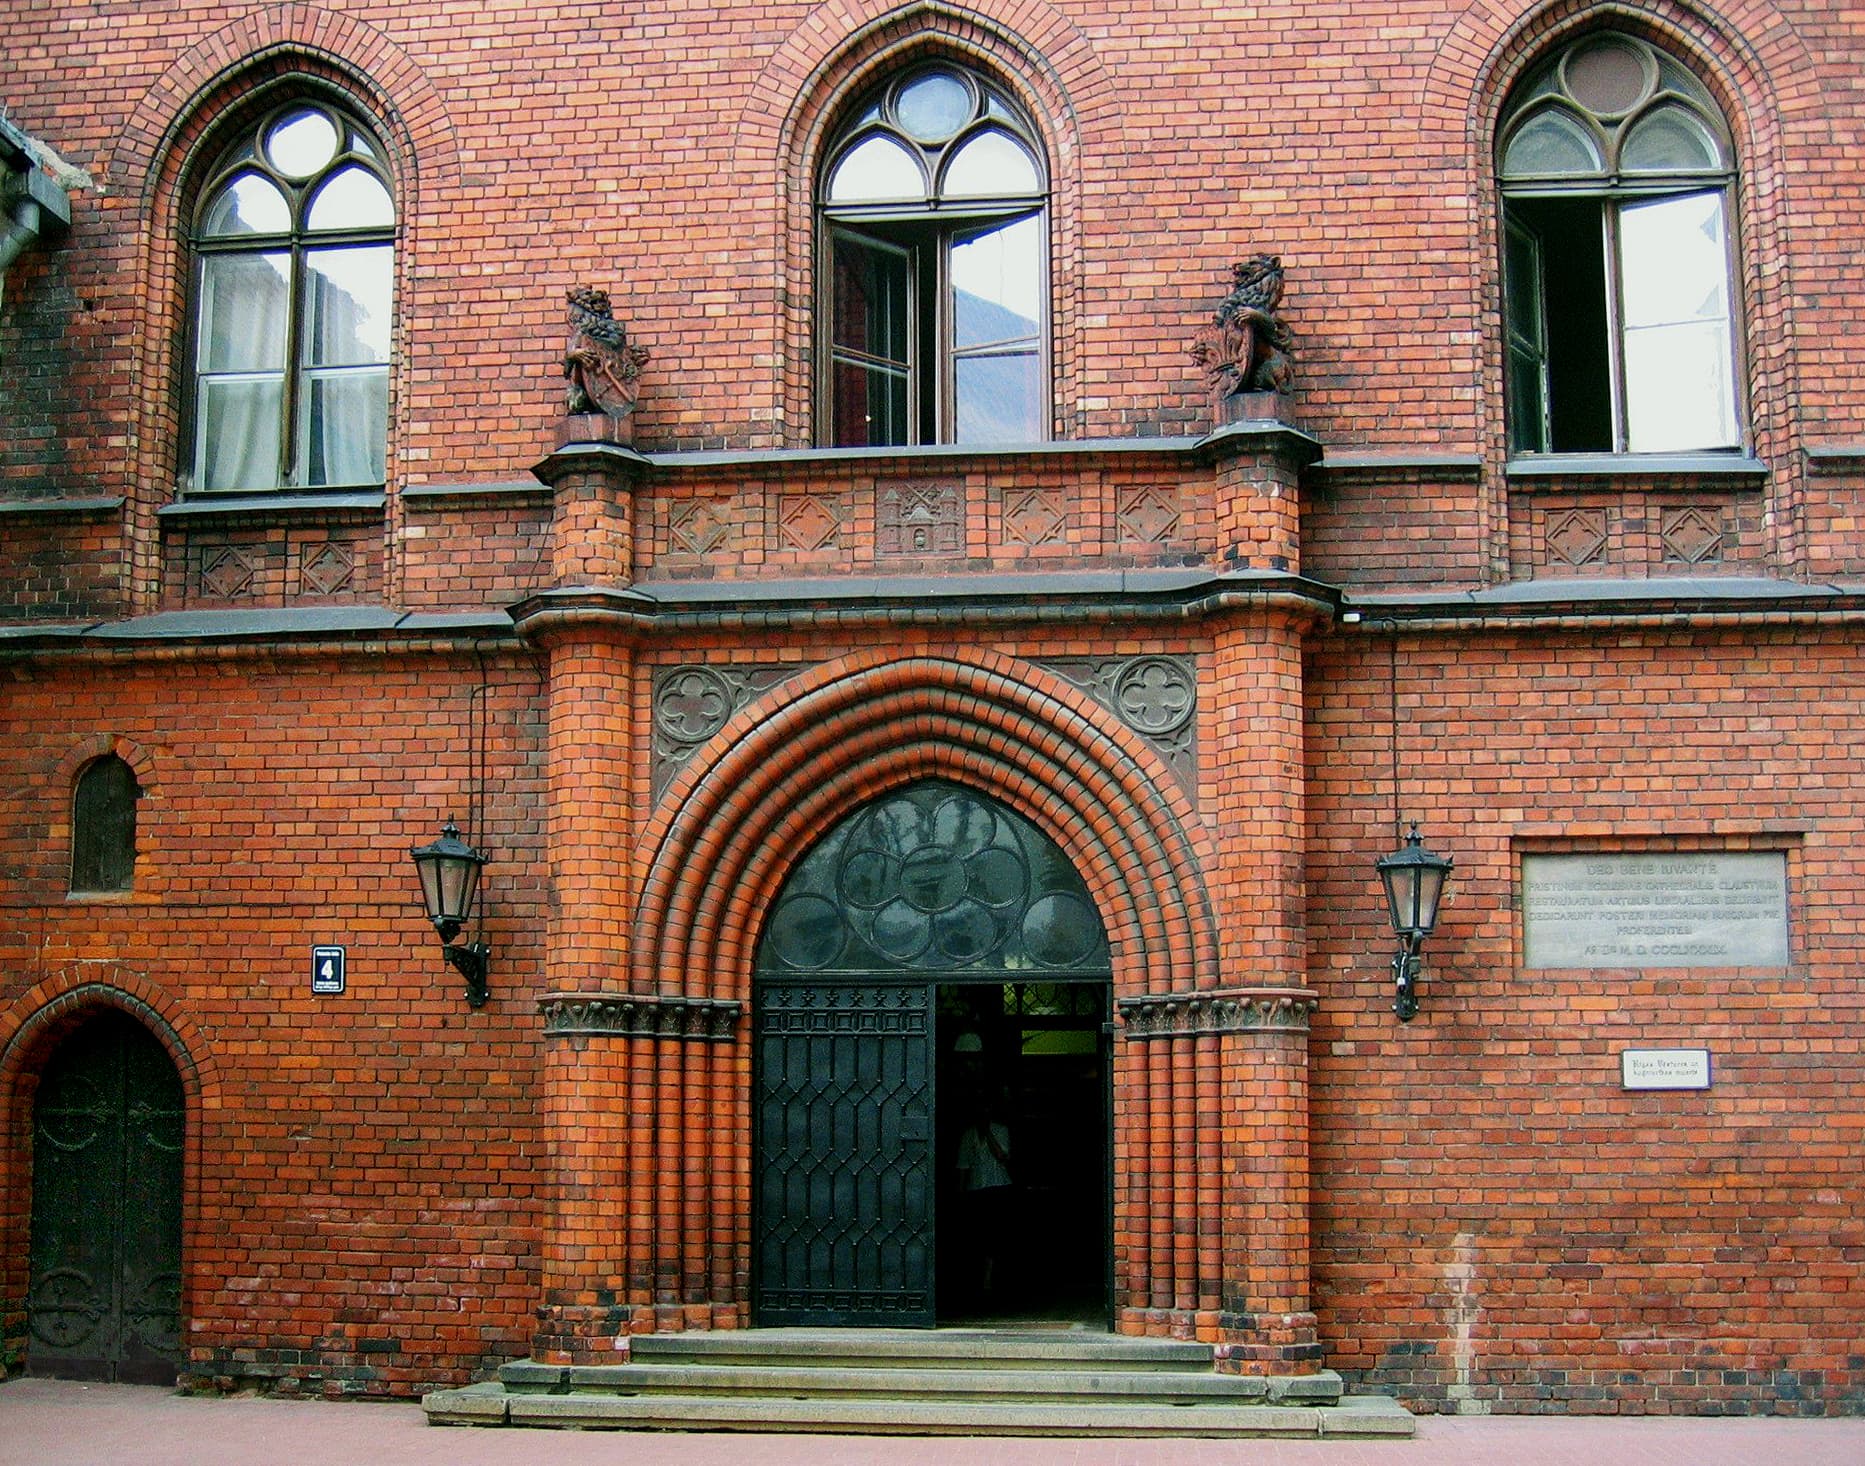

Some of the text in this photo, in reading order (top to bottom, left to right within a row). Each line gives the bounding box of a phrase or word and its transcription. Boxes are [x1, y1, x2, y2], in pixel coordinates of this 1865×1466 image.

[1586, 864, 1614, 876] DEO
[1619, 864, 1655, 876] BENE
[321, 959, 333, 979] 4
